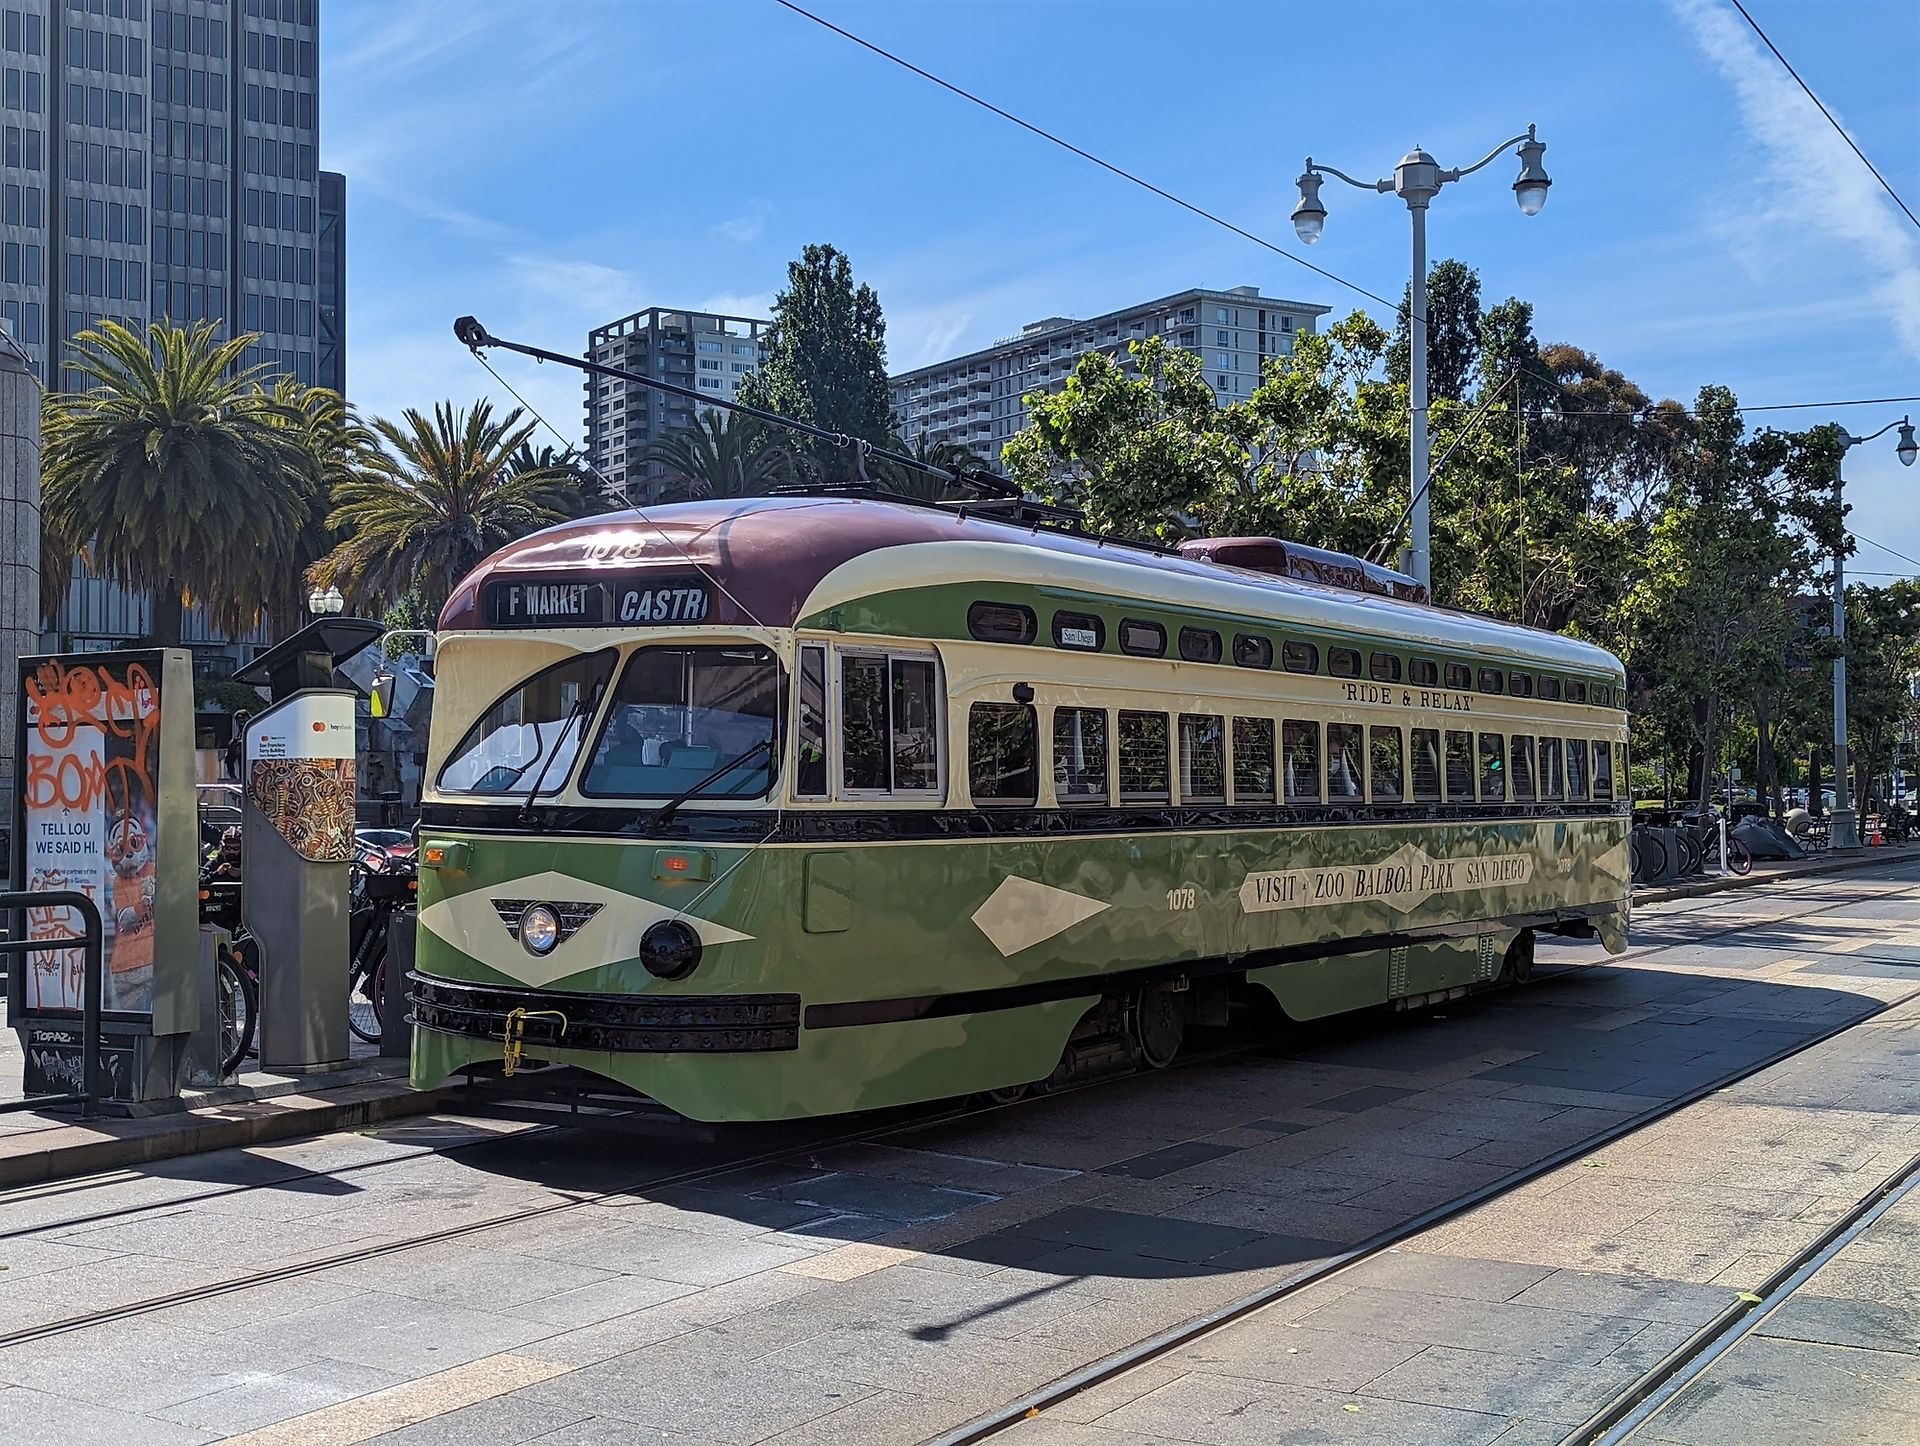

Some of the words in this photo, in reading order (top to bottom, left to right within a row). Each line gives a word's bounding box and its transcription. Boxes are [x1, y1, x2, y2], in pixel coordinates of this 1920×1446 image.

[581, 539, 647, 559] 1078
[509, 586, 520, 616] F
[526, 584, 588, 616] MARKET
[1064, 629, 1076, 641] San
[1077, 631, 1094, 645] Diego
[41, 823, 66, 836] TELL
[68, 822, 91, 836] LOU
[35, 841, 53, 854] WE
[55, 841, 81, 854] SAID
[83, 841, 98, 854] HI.
[1256, 875, 1297, 904] VISIT
[1315, 872, 1345, 898] ZOO
[1355, 865, 1413, 897] BALBOA
[1420, 862, 1455, 891] PARK
[1466, 861, 1488, 884] SAN
[1492, 858, 1525, 882] DIEGO
[1167, 888, 1196, 911] 1078
